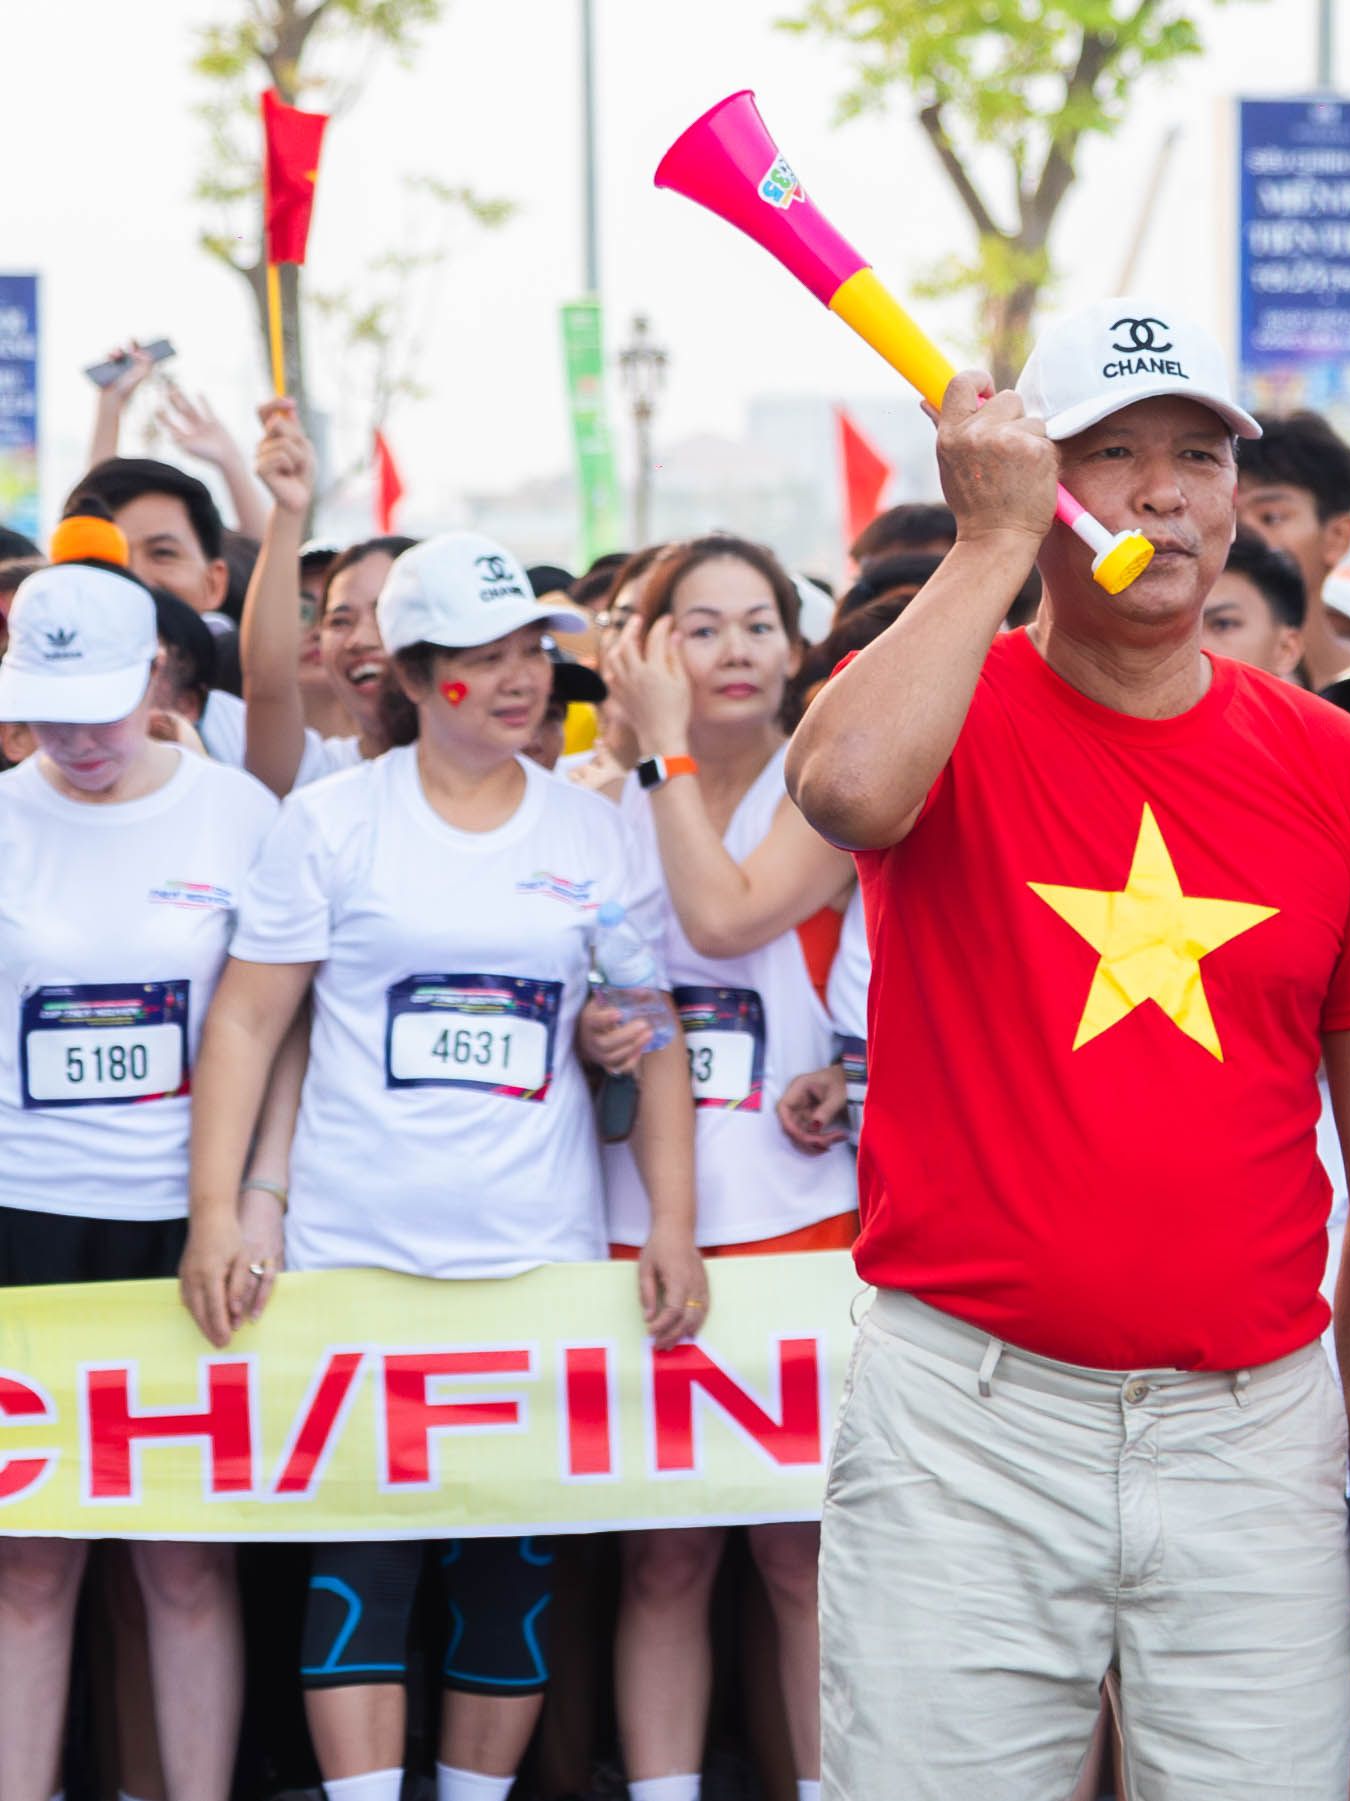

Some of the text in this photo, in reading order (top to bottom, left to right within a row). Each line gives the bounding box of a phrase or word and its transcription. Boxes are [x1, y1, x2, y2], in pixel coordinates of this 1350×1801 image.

[1103, 357, 1190, 379] CHANEL
[66, 1044, 148, 1083] 5180
[431, 1028, 513, 1070] 4631
[687, 1047, 713, 1082] 3
